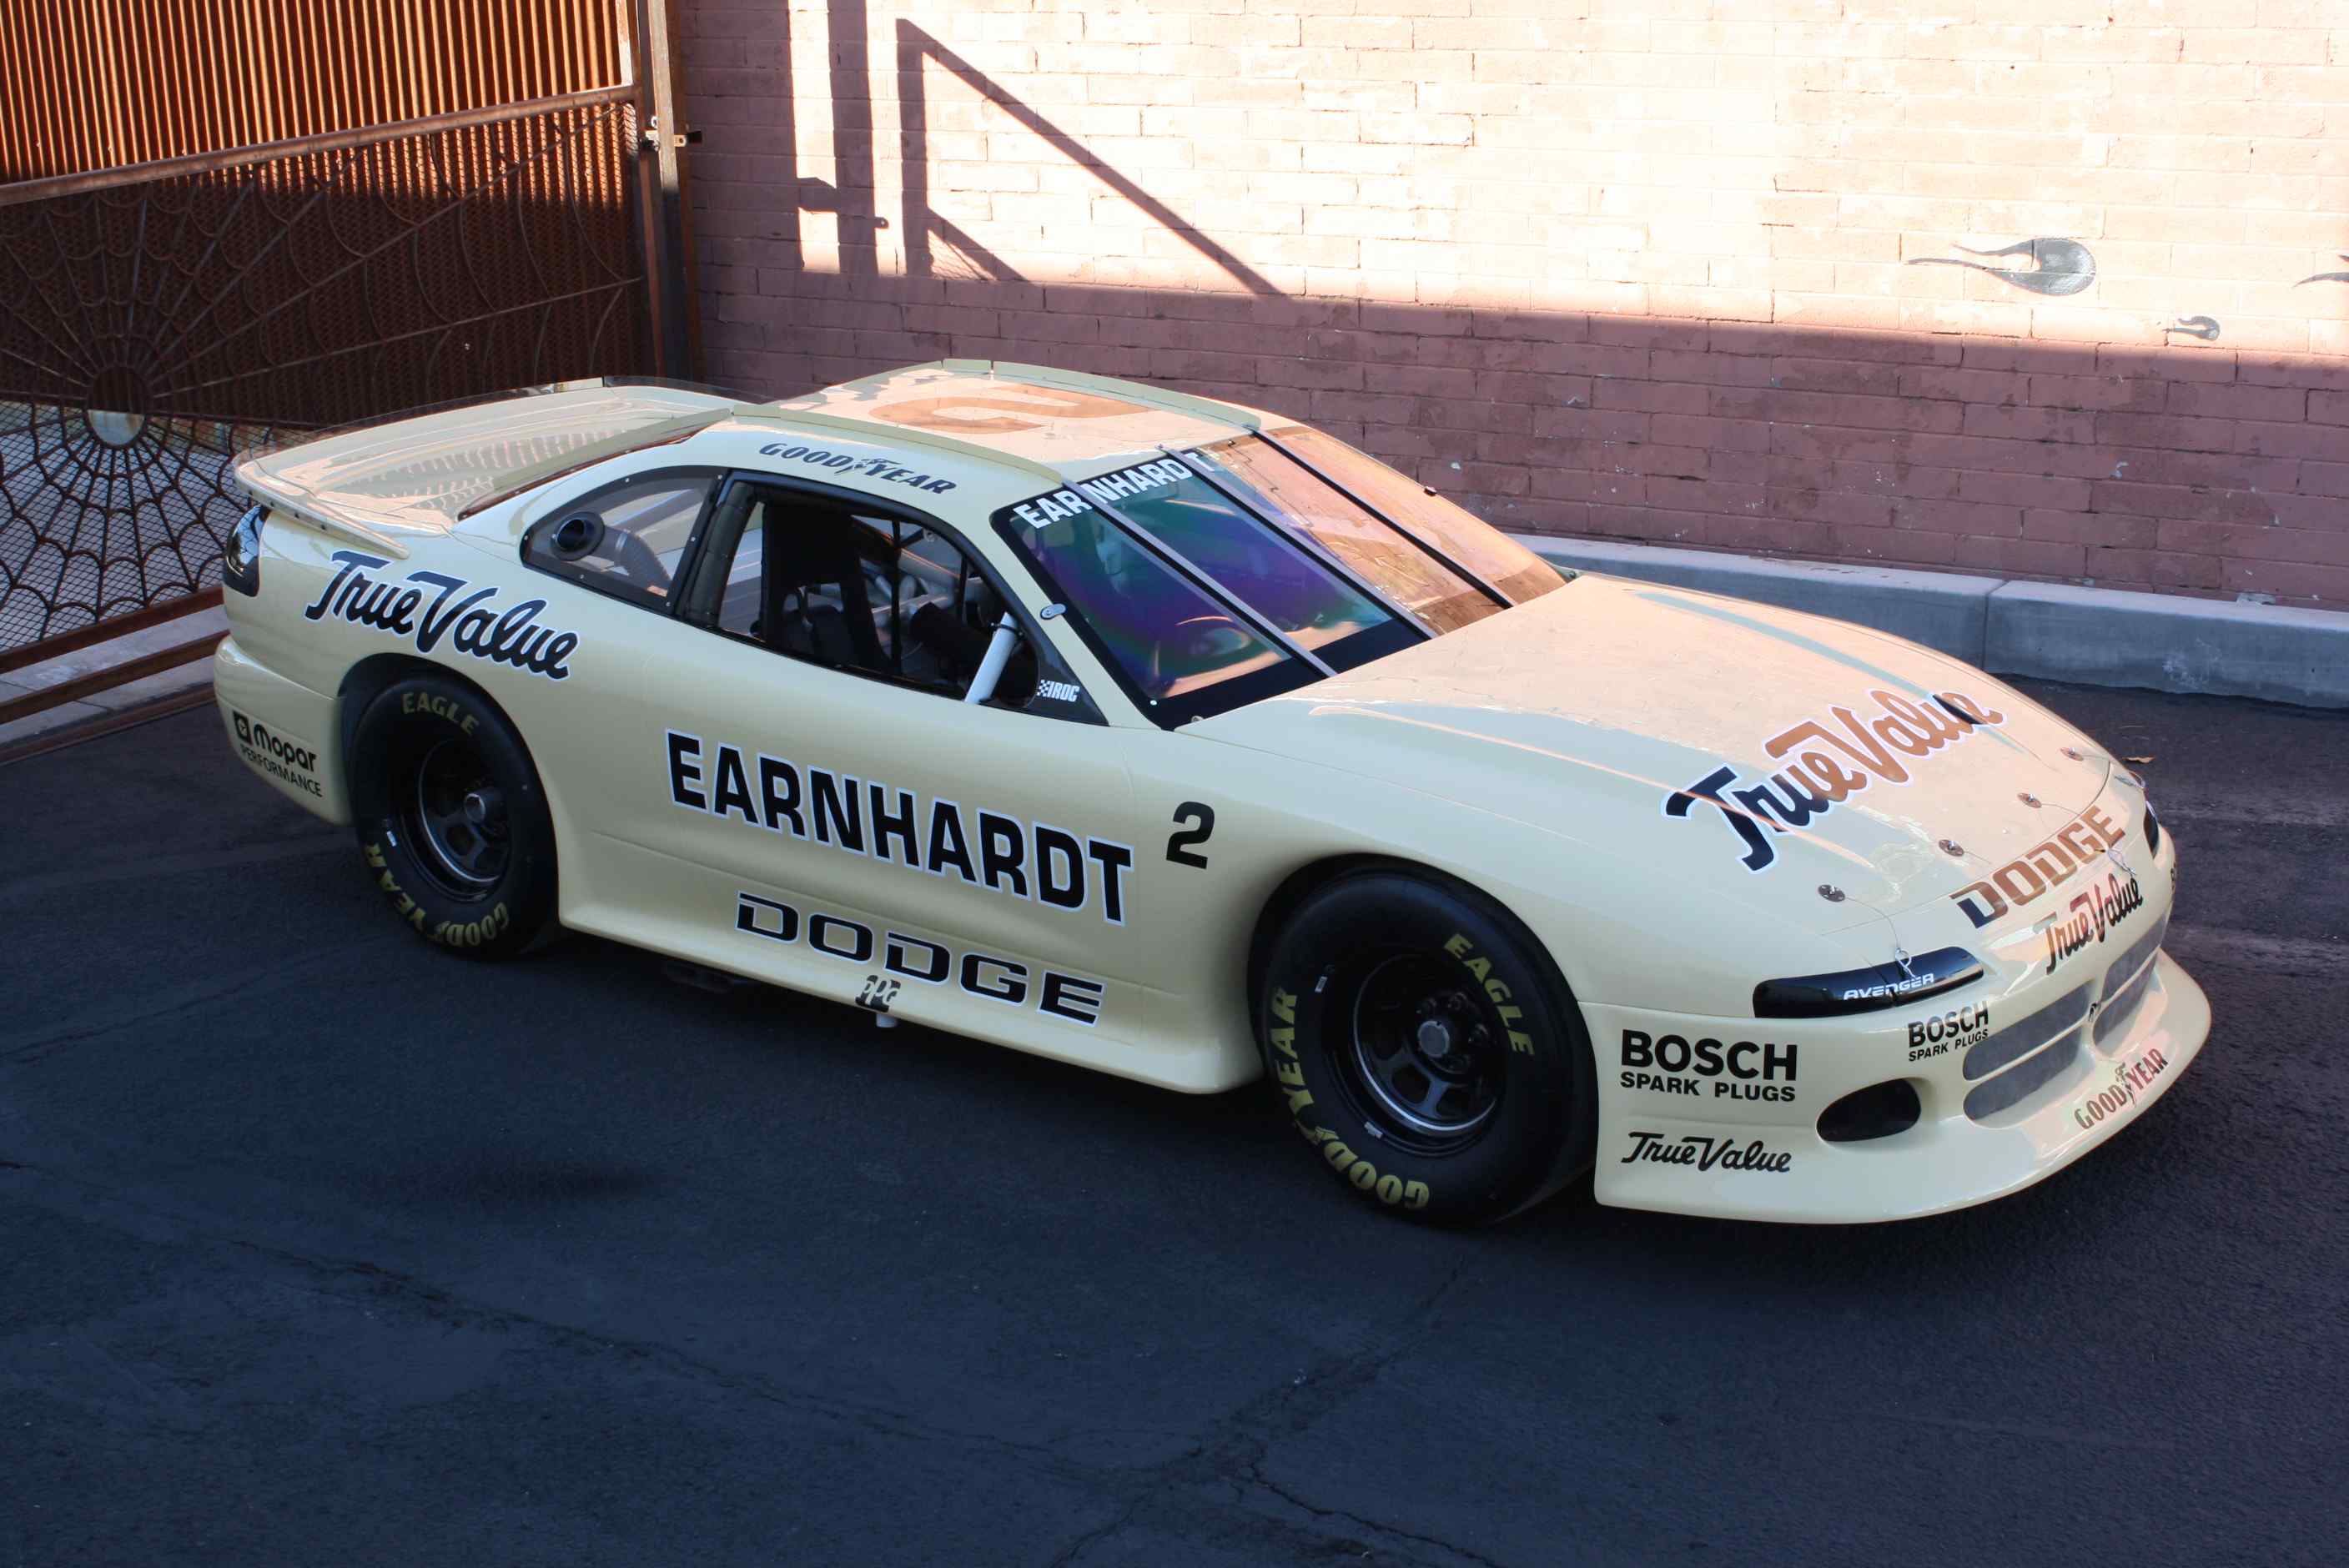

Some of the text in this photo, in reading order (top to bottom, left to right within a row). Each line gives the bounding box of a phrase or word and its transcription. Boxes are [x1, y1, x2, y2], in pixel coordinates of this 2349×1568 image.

[401, 691, 480, 737] EAGLE
[1046, 681, 1080, 702] IROC
[239, 742, 324, 798] PERFORMANCE
[666, 729, 1134, 926] EARNHARDT
[1165, 801, 1215, 869] 2
[1949, 804, 2126, 929] DODGE
[734, 891, 1106, 1028] DODGE
[1843, 972, 1934, 1001] AVENGER
[1443, 933, 1536, 1058] EAGLE
[1907, 1000, 1989, 1048] BOSCH
[1909, 1028, 1989, 1063] SPARK PLUGS
[1621, 1028, 1798, 1082] BOSCH
[1620, 1071, 1796, 1102] SPARK PLUGS
